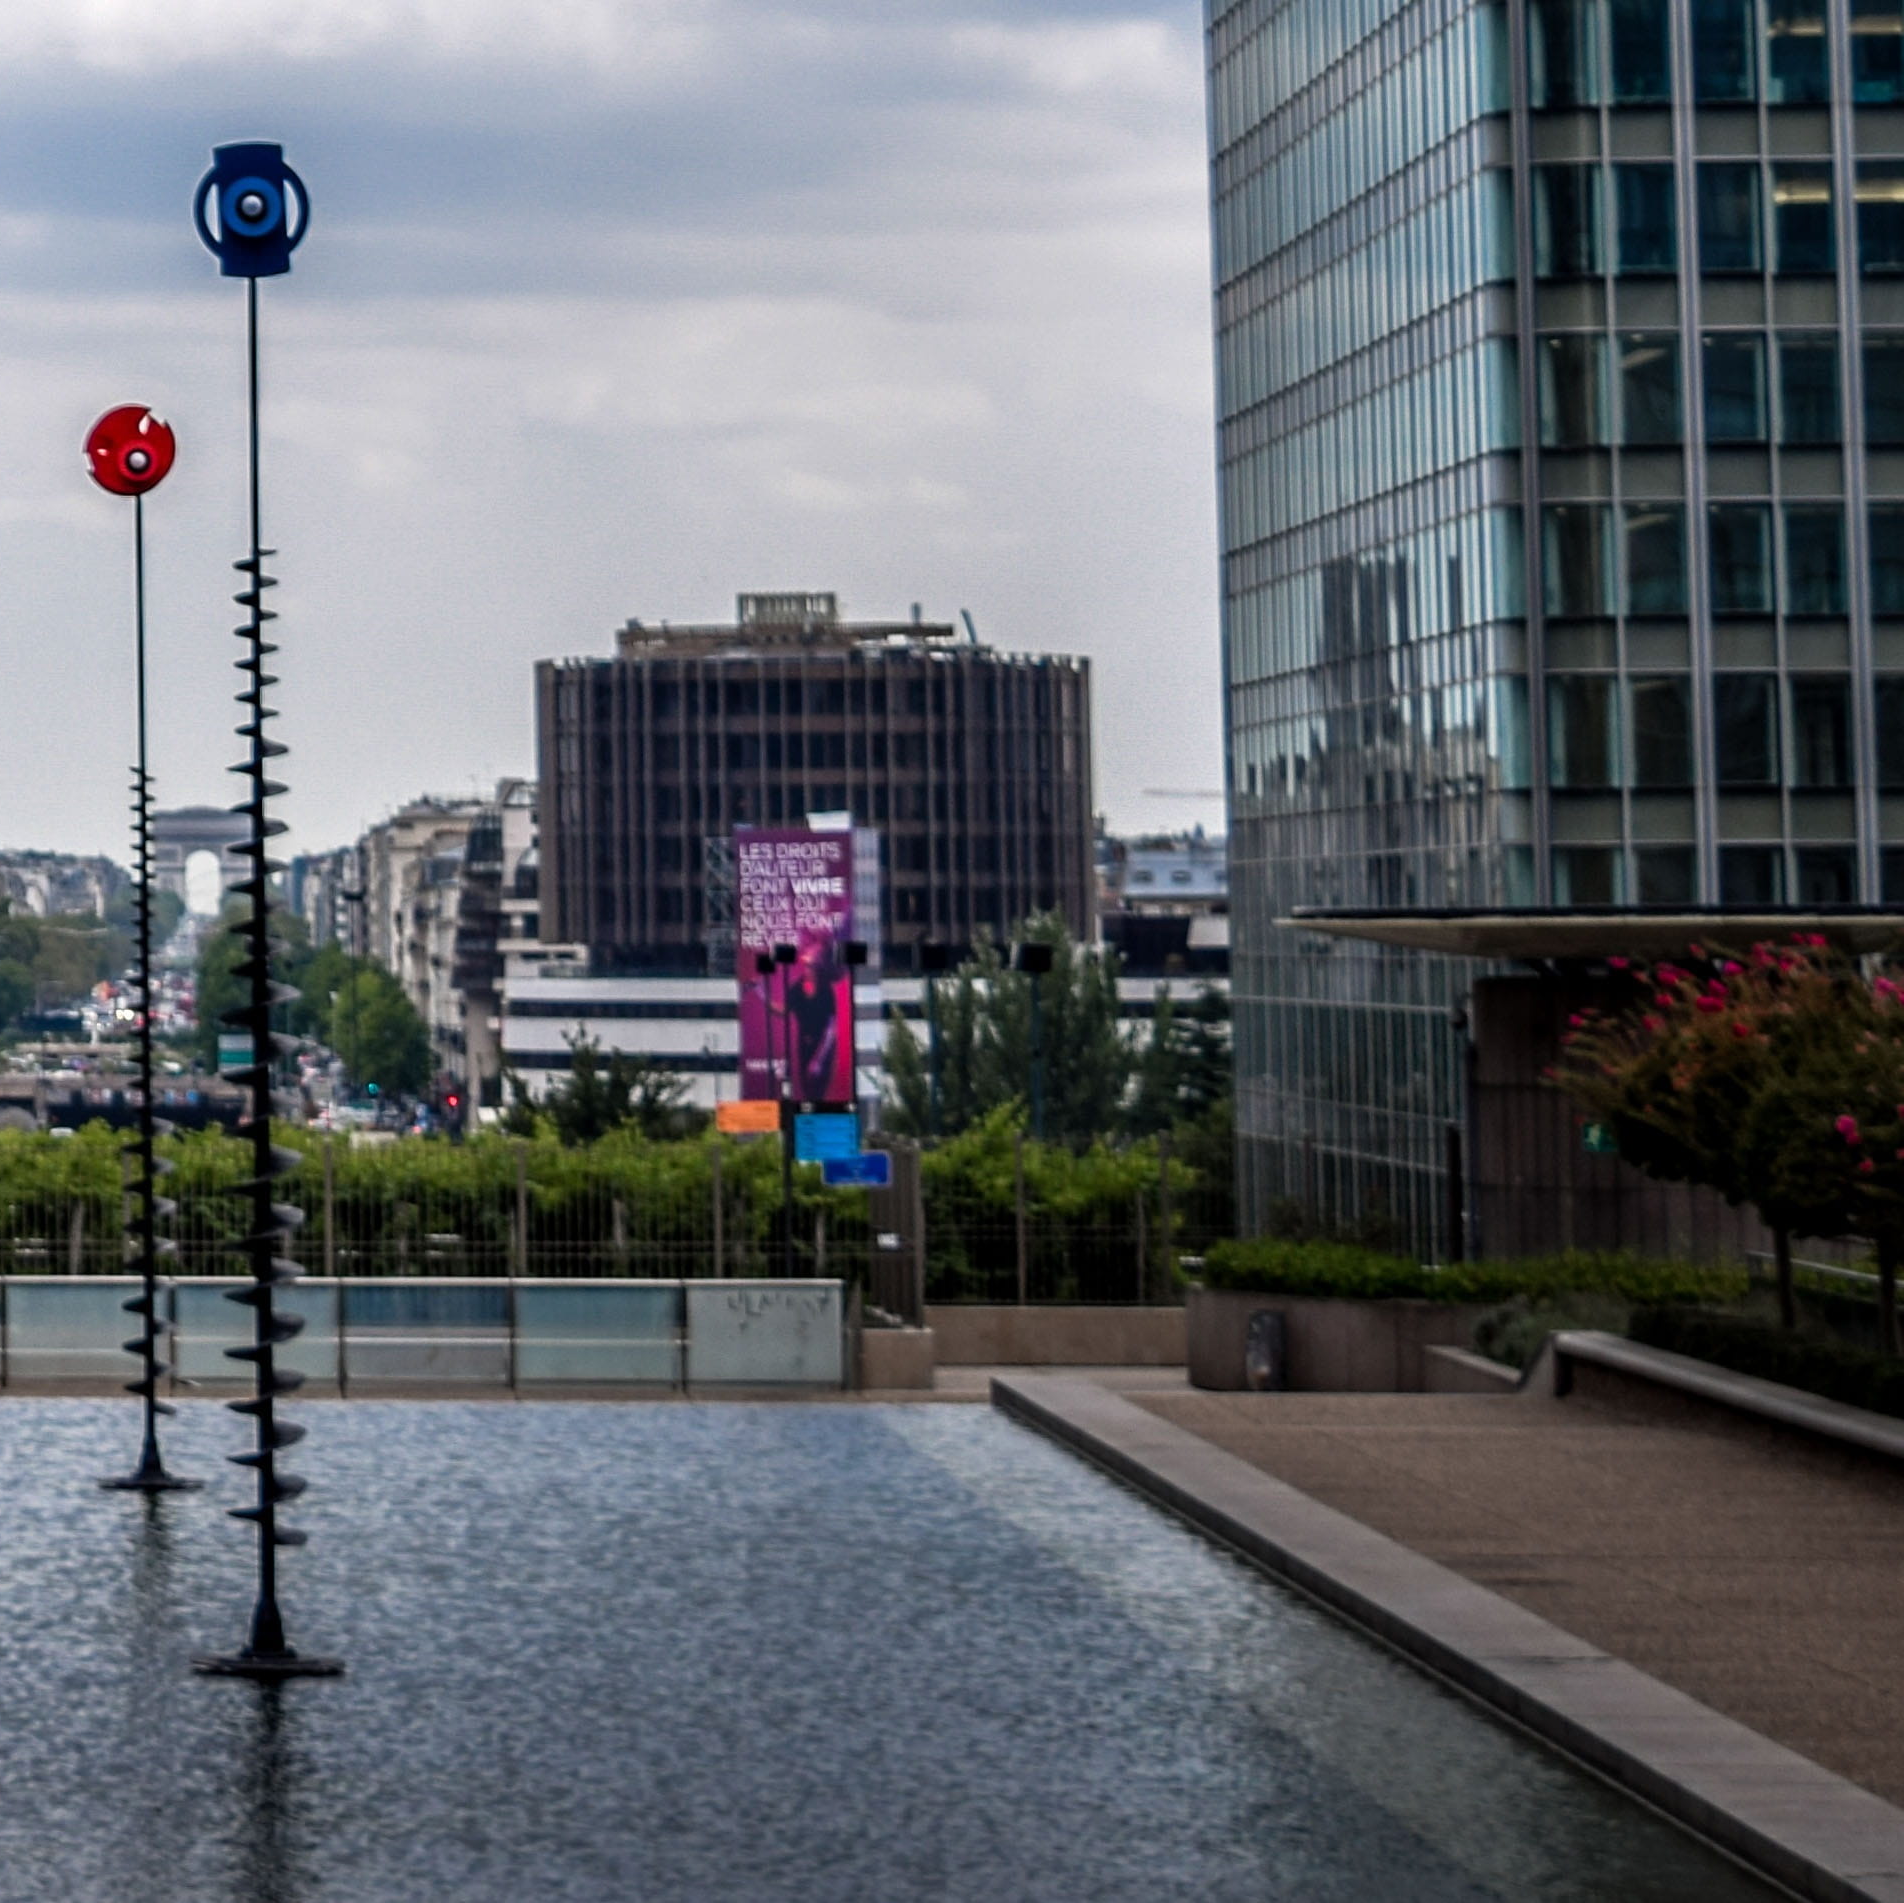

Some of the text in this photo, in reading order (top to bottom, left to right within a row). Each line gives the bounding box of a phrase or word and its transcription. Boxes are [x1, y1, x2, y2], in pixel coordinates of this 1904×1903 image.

[739, 842, 841, 860] LES DROITS
[740, 877, 844, 895] FONT VIVRE
[740, 895, 827, 912] CEUX QUI
[741, 912, 843, 929] NOUS FONT
